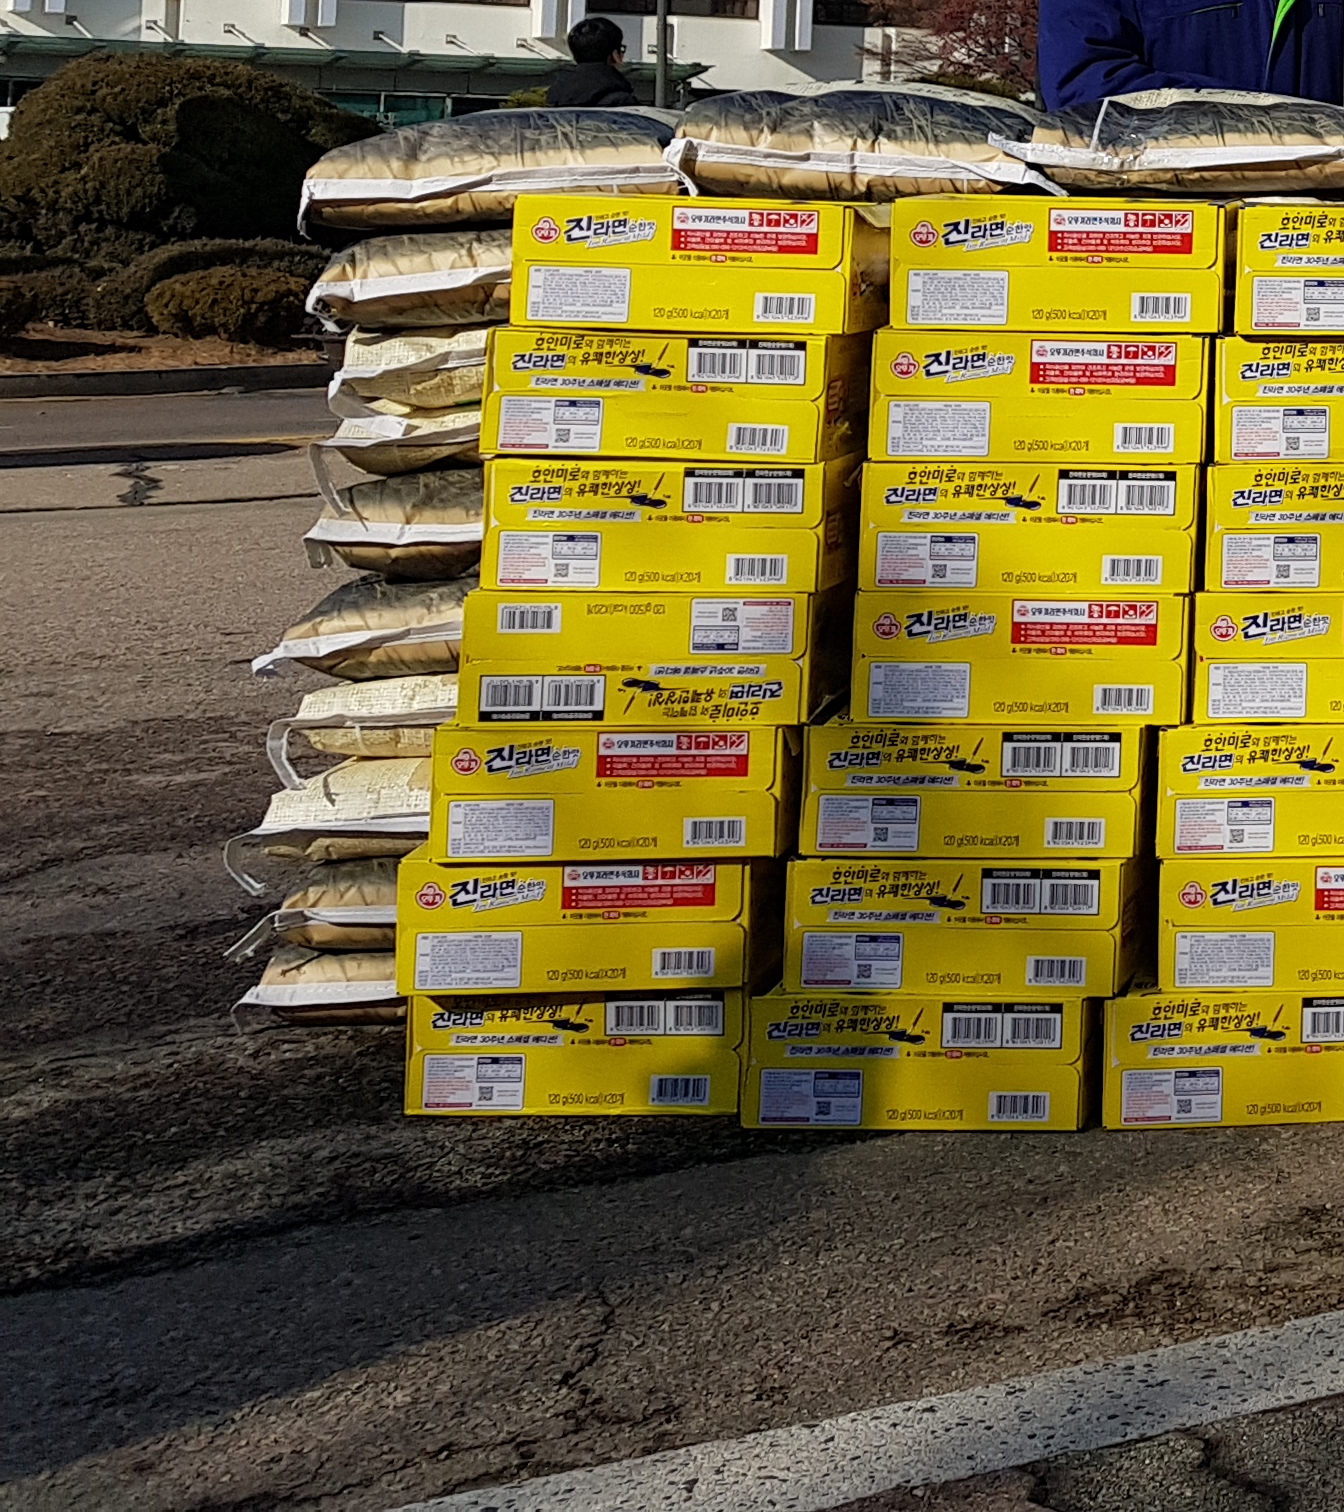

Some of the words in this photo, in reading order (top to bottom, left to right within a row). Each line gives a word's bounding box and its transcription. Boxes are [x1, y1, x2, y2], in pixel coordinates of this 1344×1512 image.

[564, 215, 629, 242] 진라면
[942, 218, 1006, 245] 진라면
[923, 350, 987, 376] 진라면
[905, 610, 969, 636] 진라면
[1241, 611, 1304, 638] 진라면
[485, 743, 552, 772] 진라면
[449, 877, 517, 905] 진라면
[1209, 877, 1273, 905] 진라면
